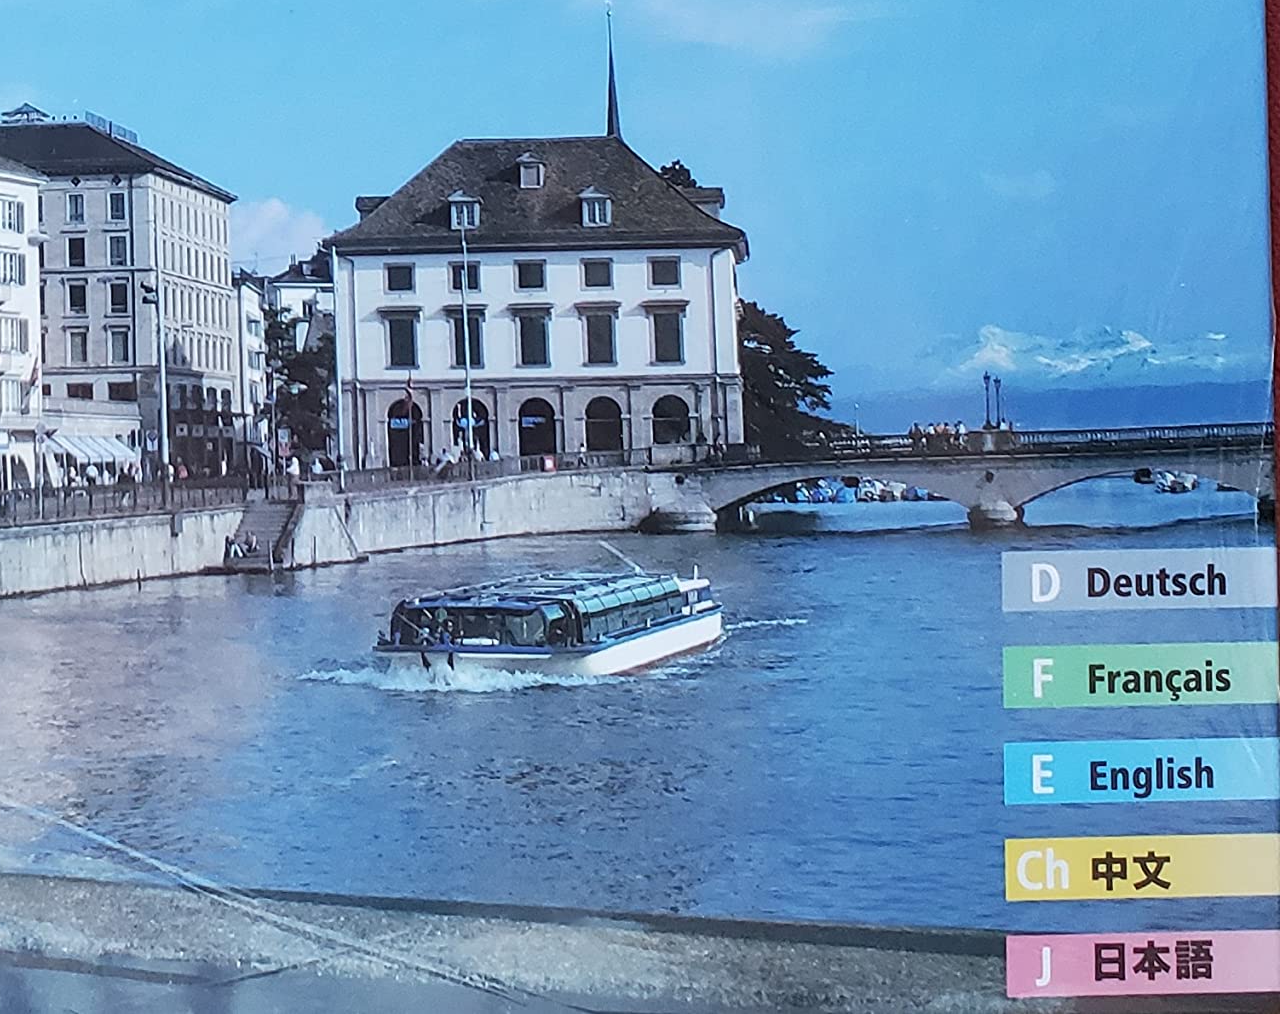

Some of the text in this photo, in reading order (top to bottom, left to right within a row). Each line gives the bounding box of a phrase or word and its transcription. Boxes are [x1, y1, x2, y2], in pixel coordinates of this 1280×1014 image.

[1031, 563, 1227, 603] D Deutsch
[1032, 659, 1231, 701] F Français
[1032, 755, 1214, 798] E English
[1016, 848, 1069, 891] Ch
[1091, 851, 1171, 891] 中文
[1035, 946, 1051, 987] J
[1094, 939, 1213, 982] 日本語
